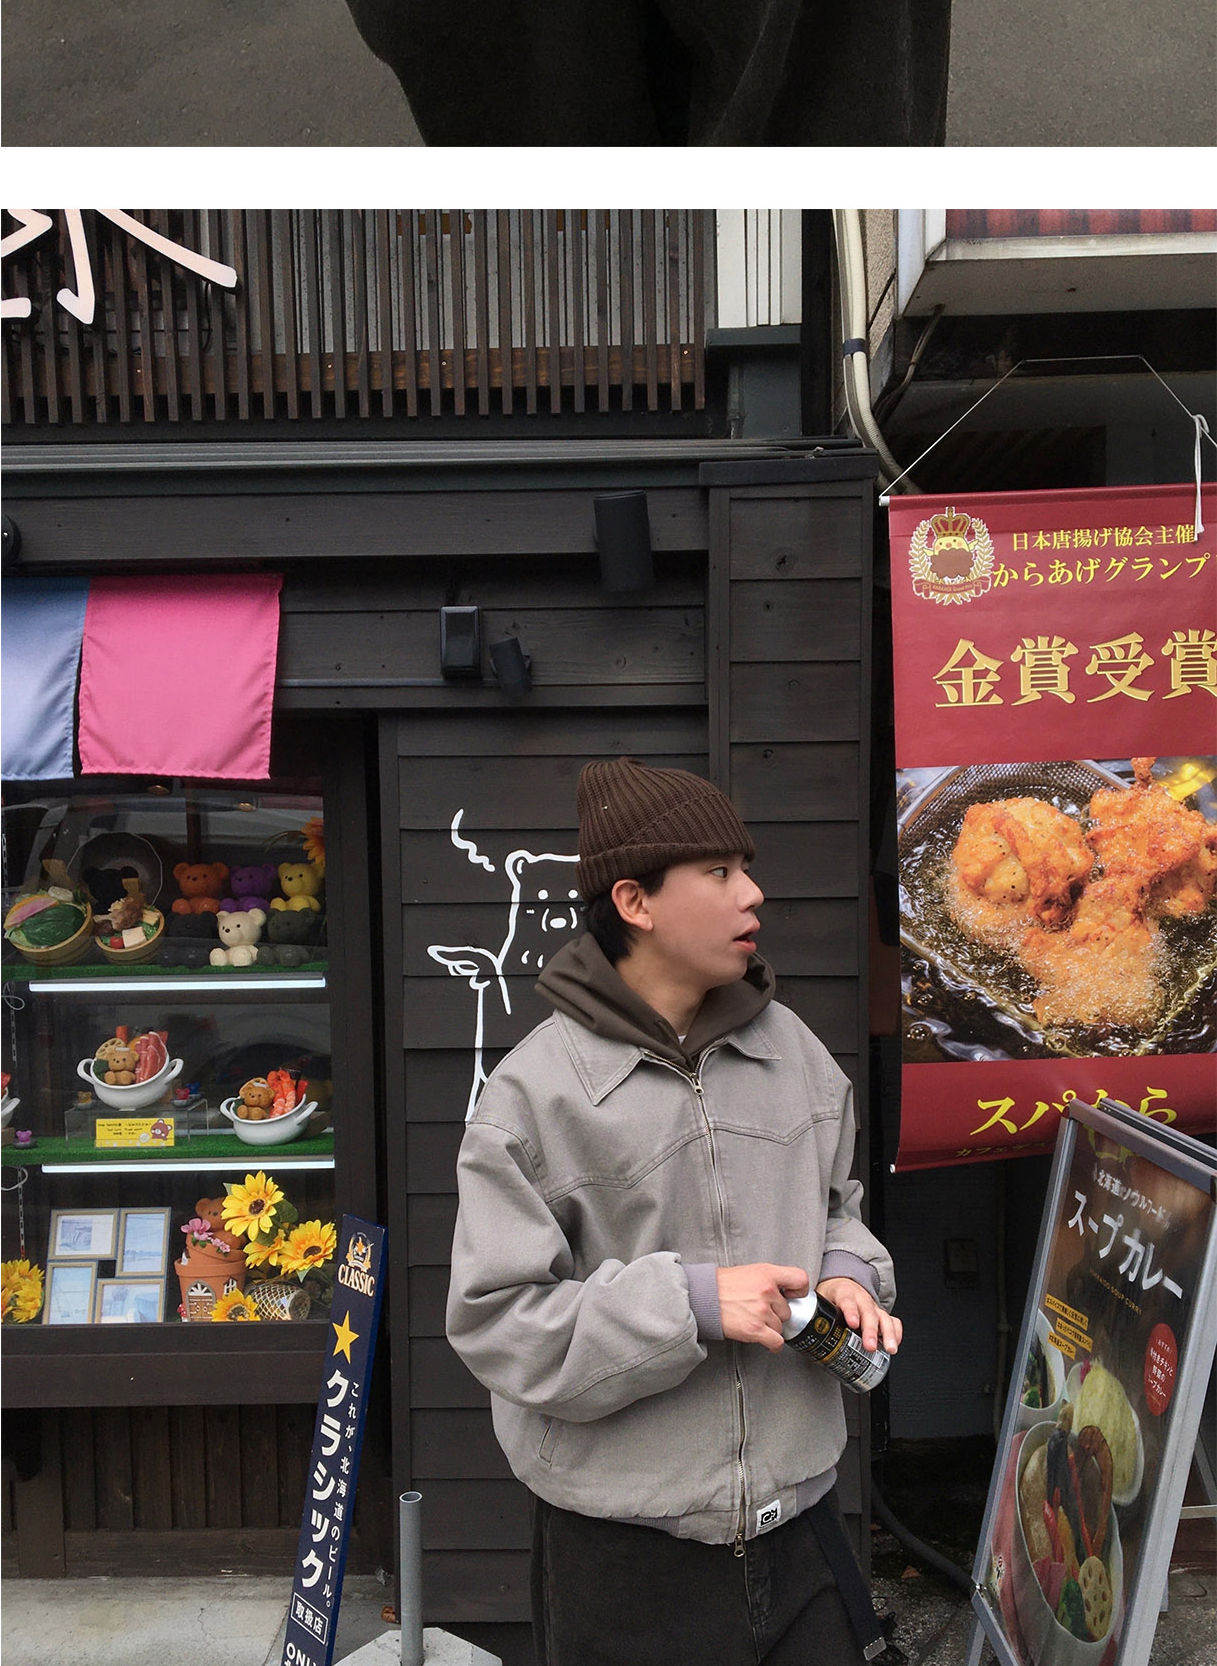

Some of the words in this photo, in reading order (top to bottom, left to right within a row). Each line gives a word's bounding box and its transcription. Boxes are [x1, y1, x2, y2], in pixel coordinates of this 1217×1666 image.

[1012, 523, 1197, 552] 日本唐揚げ協会主催
[992, 552, 1217, 588] からあげグランプ
[933, 628, 1217, 708] 金賞受賞
[1068, 1190, 1183, 1300] スープカレー
[338, 1263, 375, 1297] CLASSIC
[301, 1369, 349, 1588] クラシック
[296, 1601, 323, 1635] 取扱店
